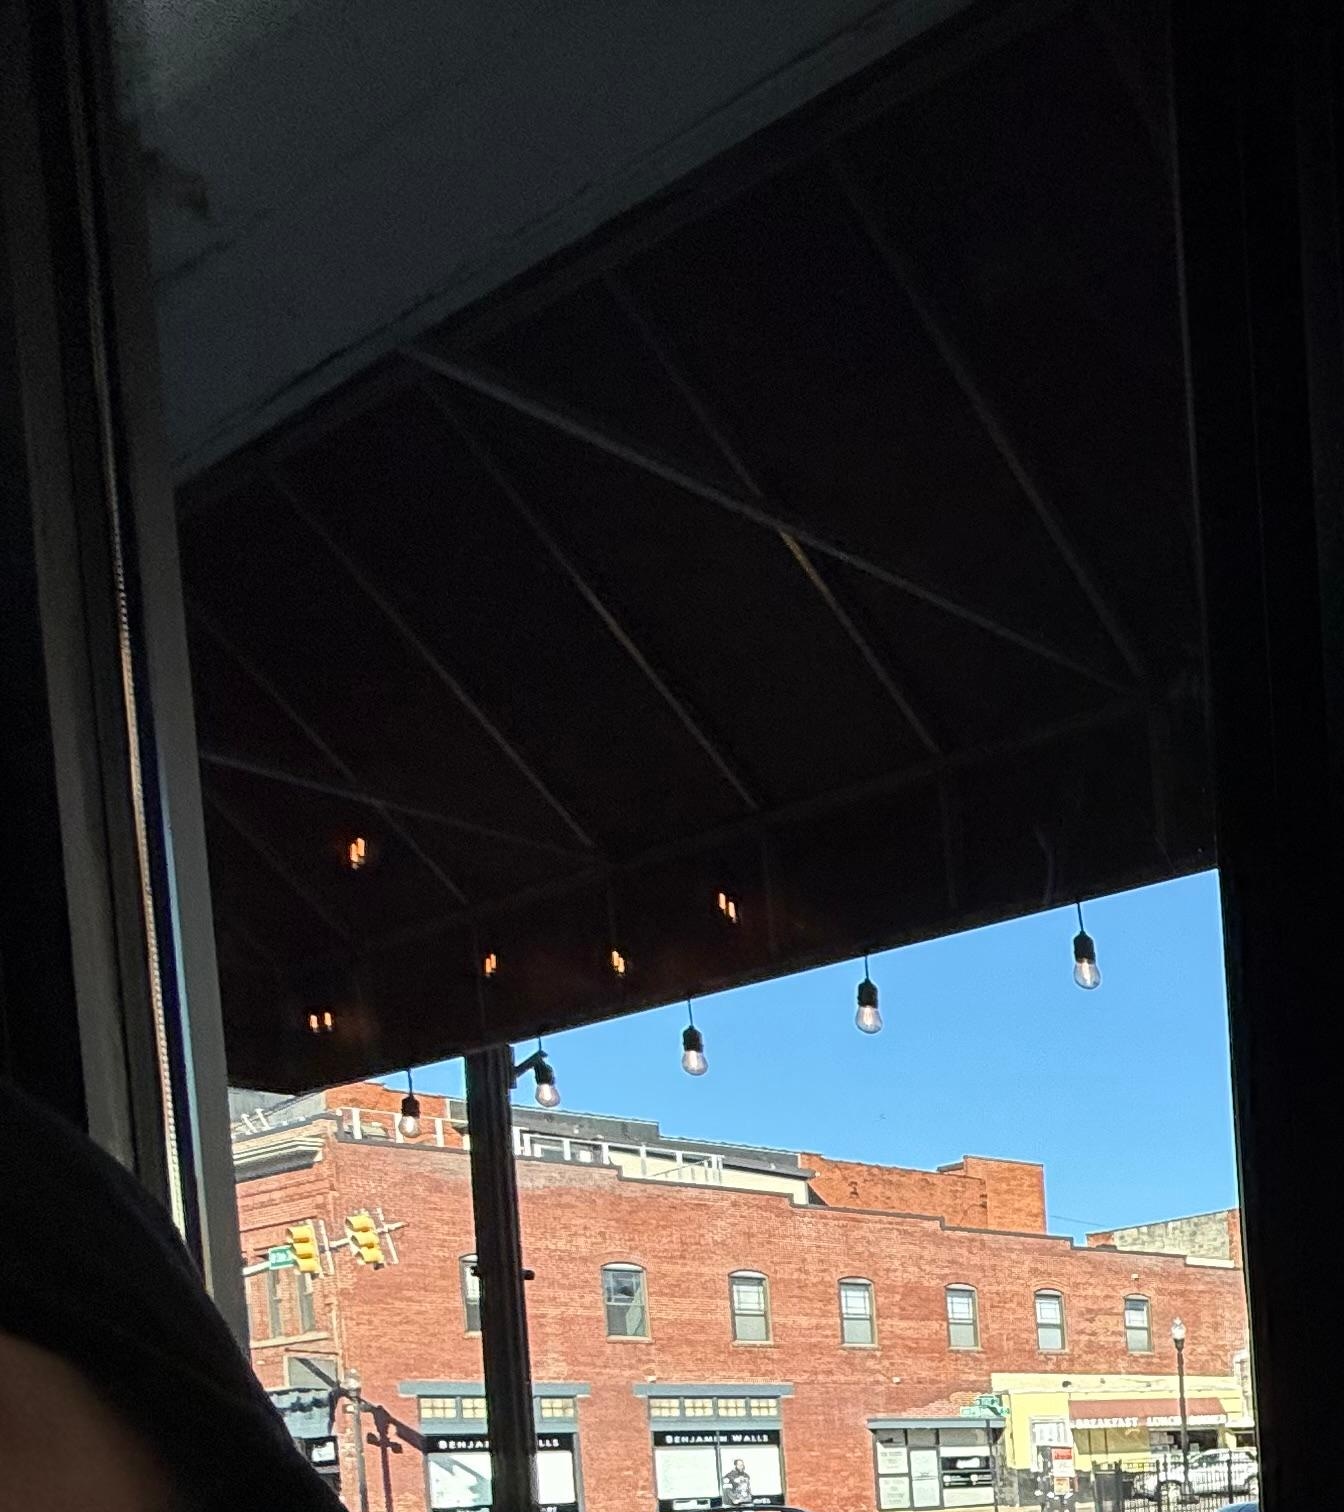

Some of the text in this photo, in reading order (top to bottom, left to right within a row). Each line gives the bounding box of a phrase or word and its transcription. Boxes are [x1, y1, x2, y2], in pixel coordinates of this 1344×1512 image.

[665, 1434, 769, 1444] BENJAMIN WALLS
[438, 1440, 490, 1449] BENJA
